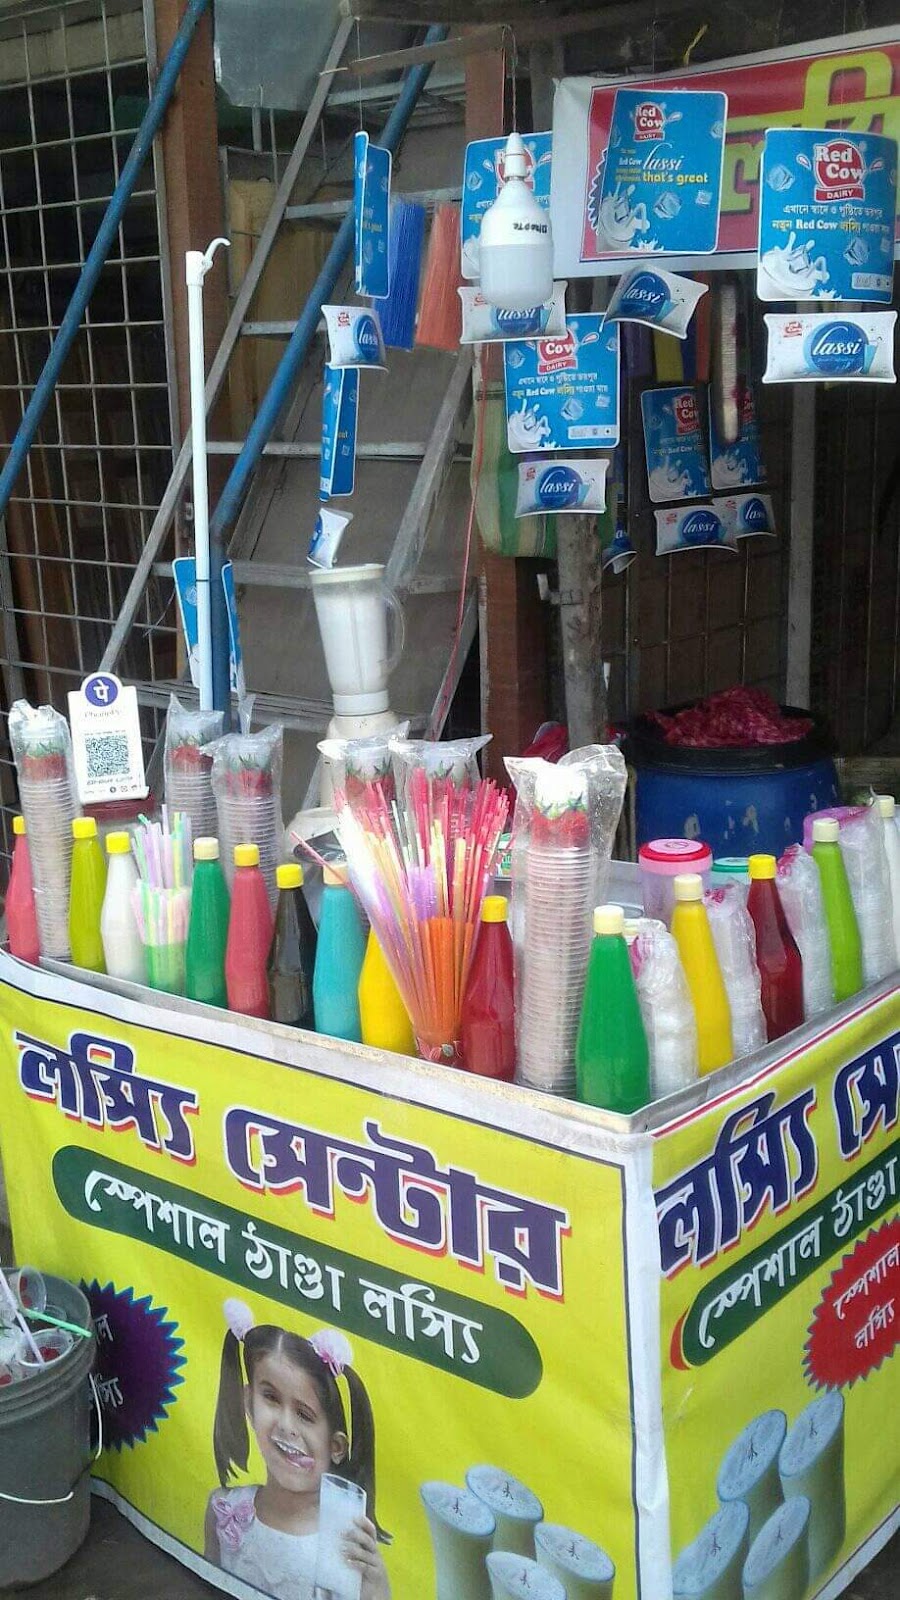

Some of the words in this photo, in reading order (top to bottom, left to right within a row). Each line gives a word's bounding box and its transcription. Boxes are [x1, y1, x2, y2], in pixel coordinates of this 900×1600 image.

[635, 105, 656, 117] Red
[639, 118, 665, 128] Cow
[643, 143, 684, 171] lassi
[814, 144, 853, 163] Red
[643, 170, 673, 182] that's
[676, 172, 708, 186] great
[826, 164, 867, 180] Cow
[826, 189, 854, 200] DAIRY
[795, 218, 815, 230] Red
[816, 219, 838, 230] Cow
[623, 275, 665, 304] lassi
[545, 341, 577, 355] Cow
[812, 325, 862, 356] lassi
[546, 361, 568, 372] DAIRY
[526, 388, 539, 397] Red
[540, 386, 555, 396] Cow
[675, 399, 694, 409] Red
[540, 469, 577, 494] lassi
[683, 512, 717, 534] lassi
[222, 1104, 572, 1304] সেন্টার
[84, 1170, 231, 1264] স্পেশাল
[699, 1214, 824, 1349] স্পেশাল
[832, 1242, 900, 1320] স্পেশাল
